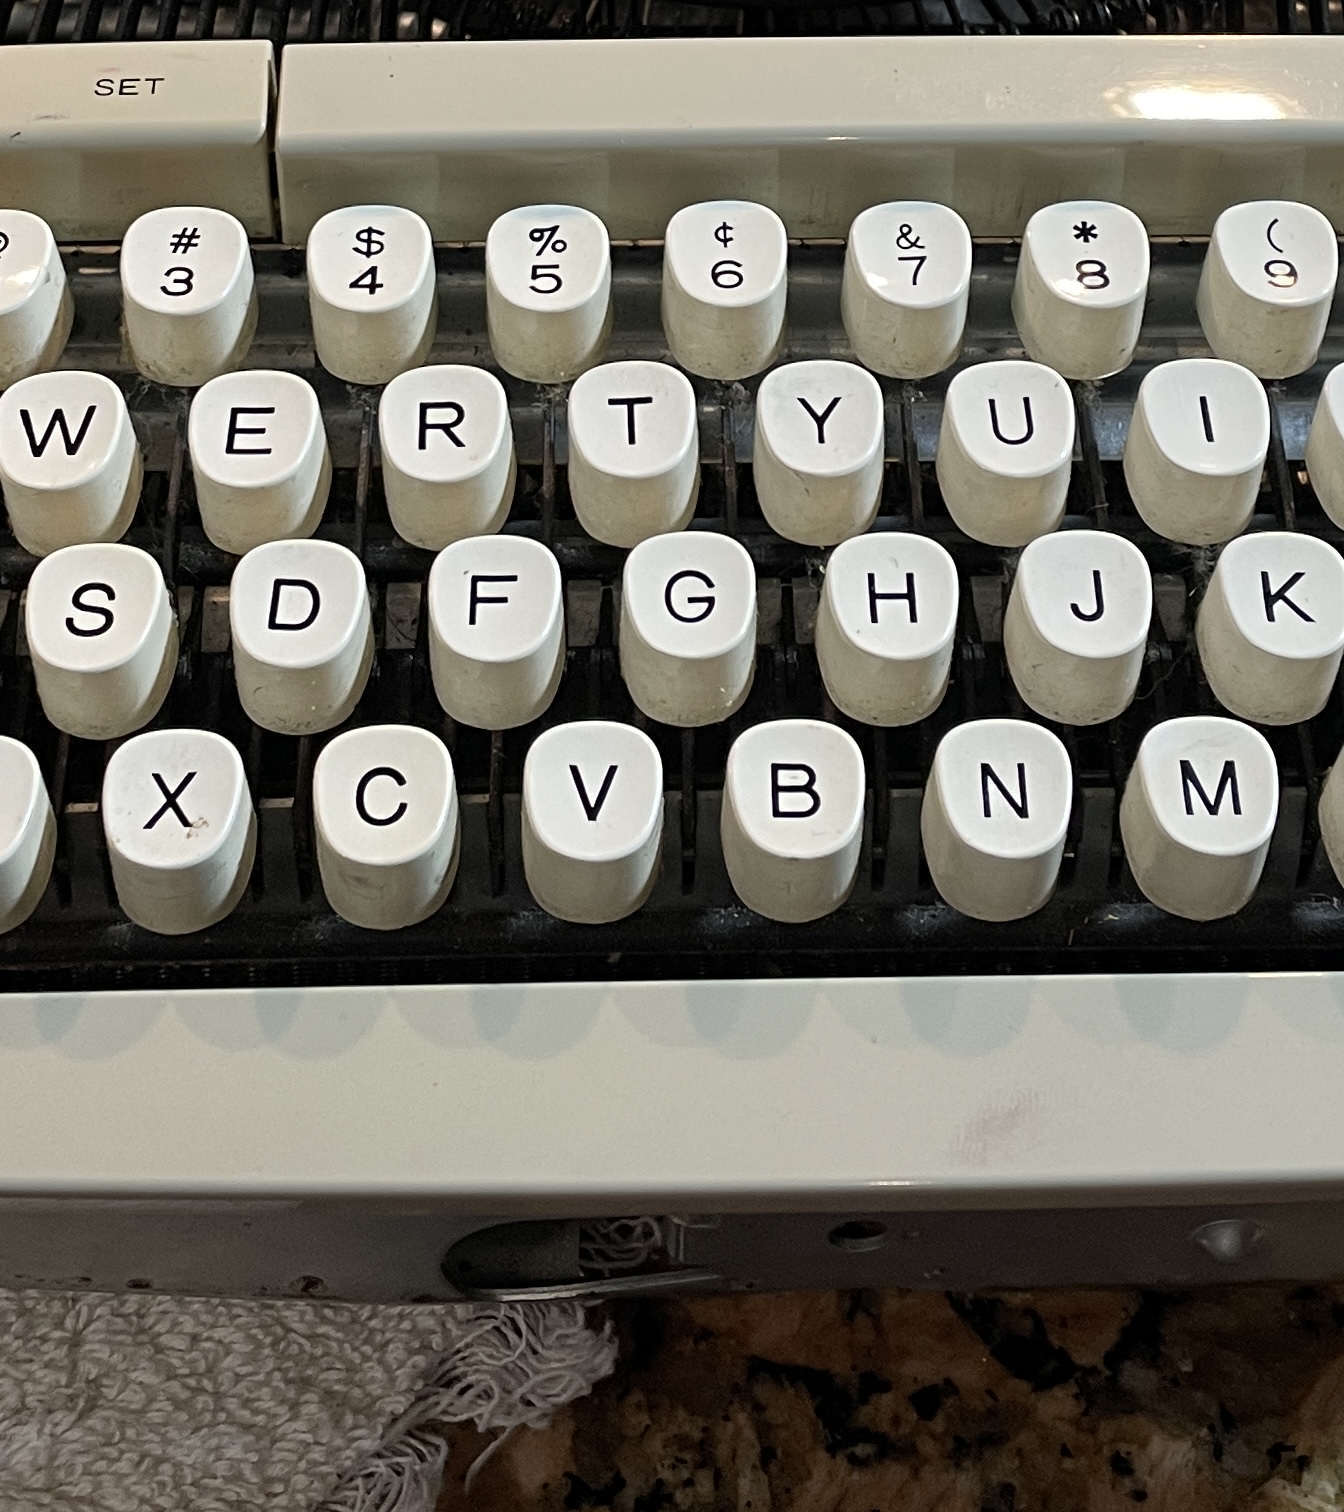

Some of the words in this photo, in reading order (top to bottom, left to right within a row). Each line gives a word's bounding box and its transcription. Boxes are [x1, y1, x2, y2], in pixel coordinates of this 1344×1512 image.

[94, 77, 165, 97] SET
[169, 227, 201, 255] #
[351, 226, 386, 259] $
[528, 224, 568, 257] %
[714, 221, 734, 249] ¢
[895, 223, 926, 250] &
[159, 266, 194, 297] 3
[348, 265, 384, 295] 4
[529, 263, 563, 294] 5
[710, 259, 744, 289] 6
[897, 255, 928, 286] 7
[1075, 259, 1110, 290] 8
[1263, 259, 1298, 288] 9
[19, 405, 97, 458] W
[225, 406, 276, 455] E
[418, 401, 466, 451] R
[607, 396, 654, 446] T
[796, 396, 842, 444] Y
[988, 396, 1034, 446] U
[1199, 395, 1215, 443] I
[65, 582, 116, 638] S
[267, 578, 321, 631] D
[468, 574, 518, 626] F
[664, 569, 716, 624] G
[867, 572, 918, 624] H
[1070, 569, 1105, 622] J
[1260, 570, 1316, 623] K
[142, 771, 198, 830] X
[355, 766, 408, 827] C
[568, 764, 619, 822] V
[770, 762, 821, 819] B
[980, 762, 1030, 819] N
[1179, 759, 1242, 816] M
